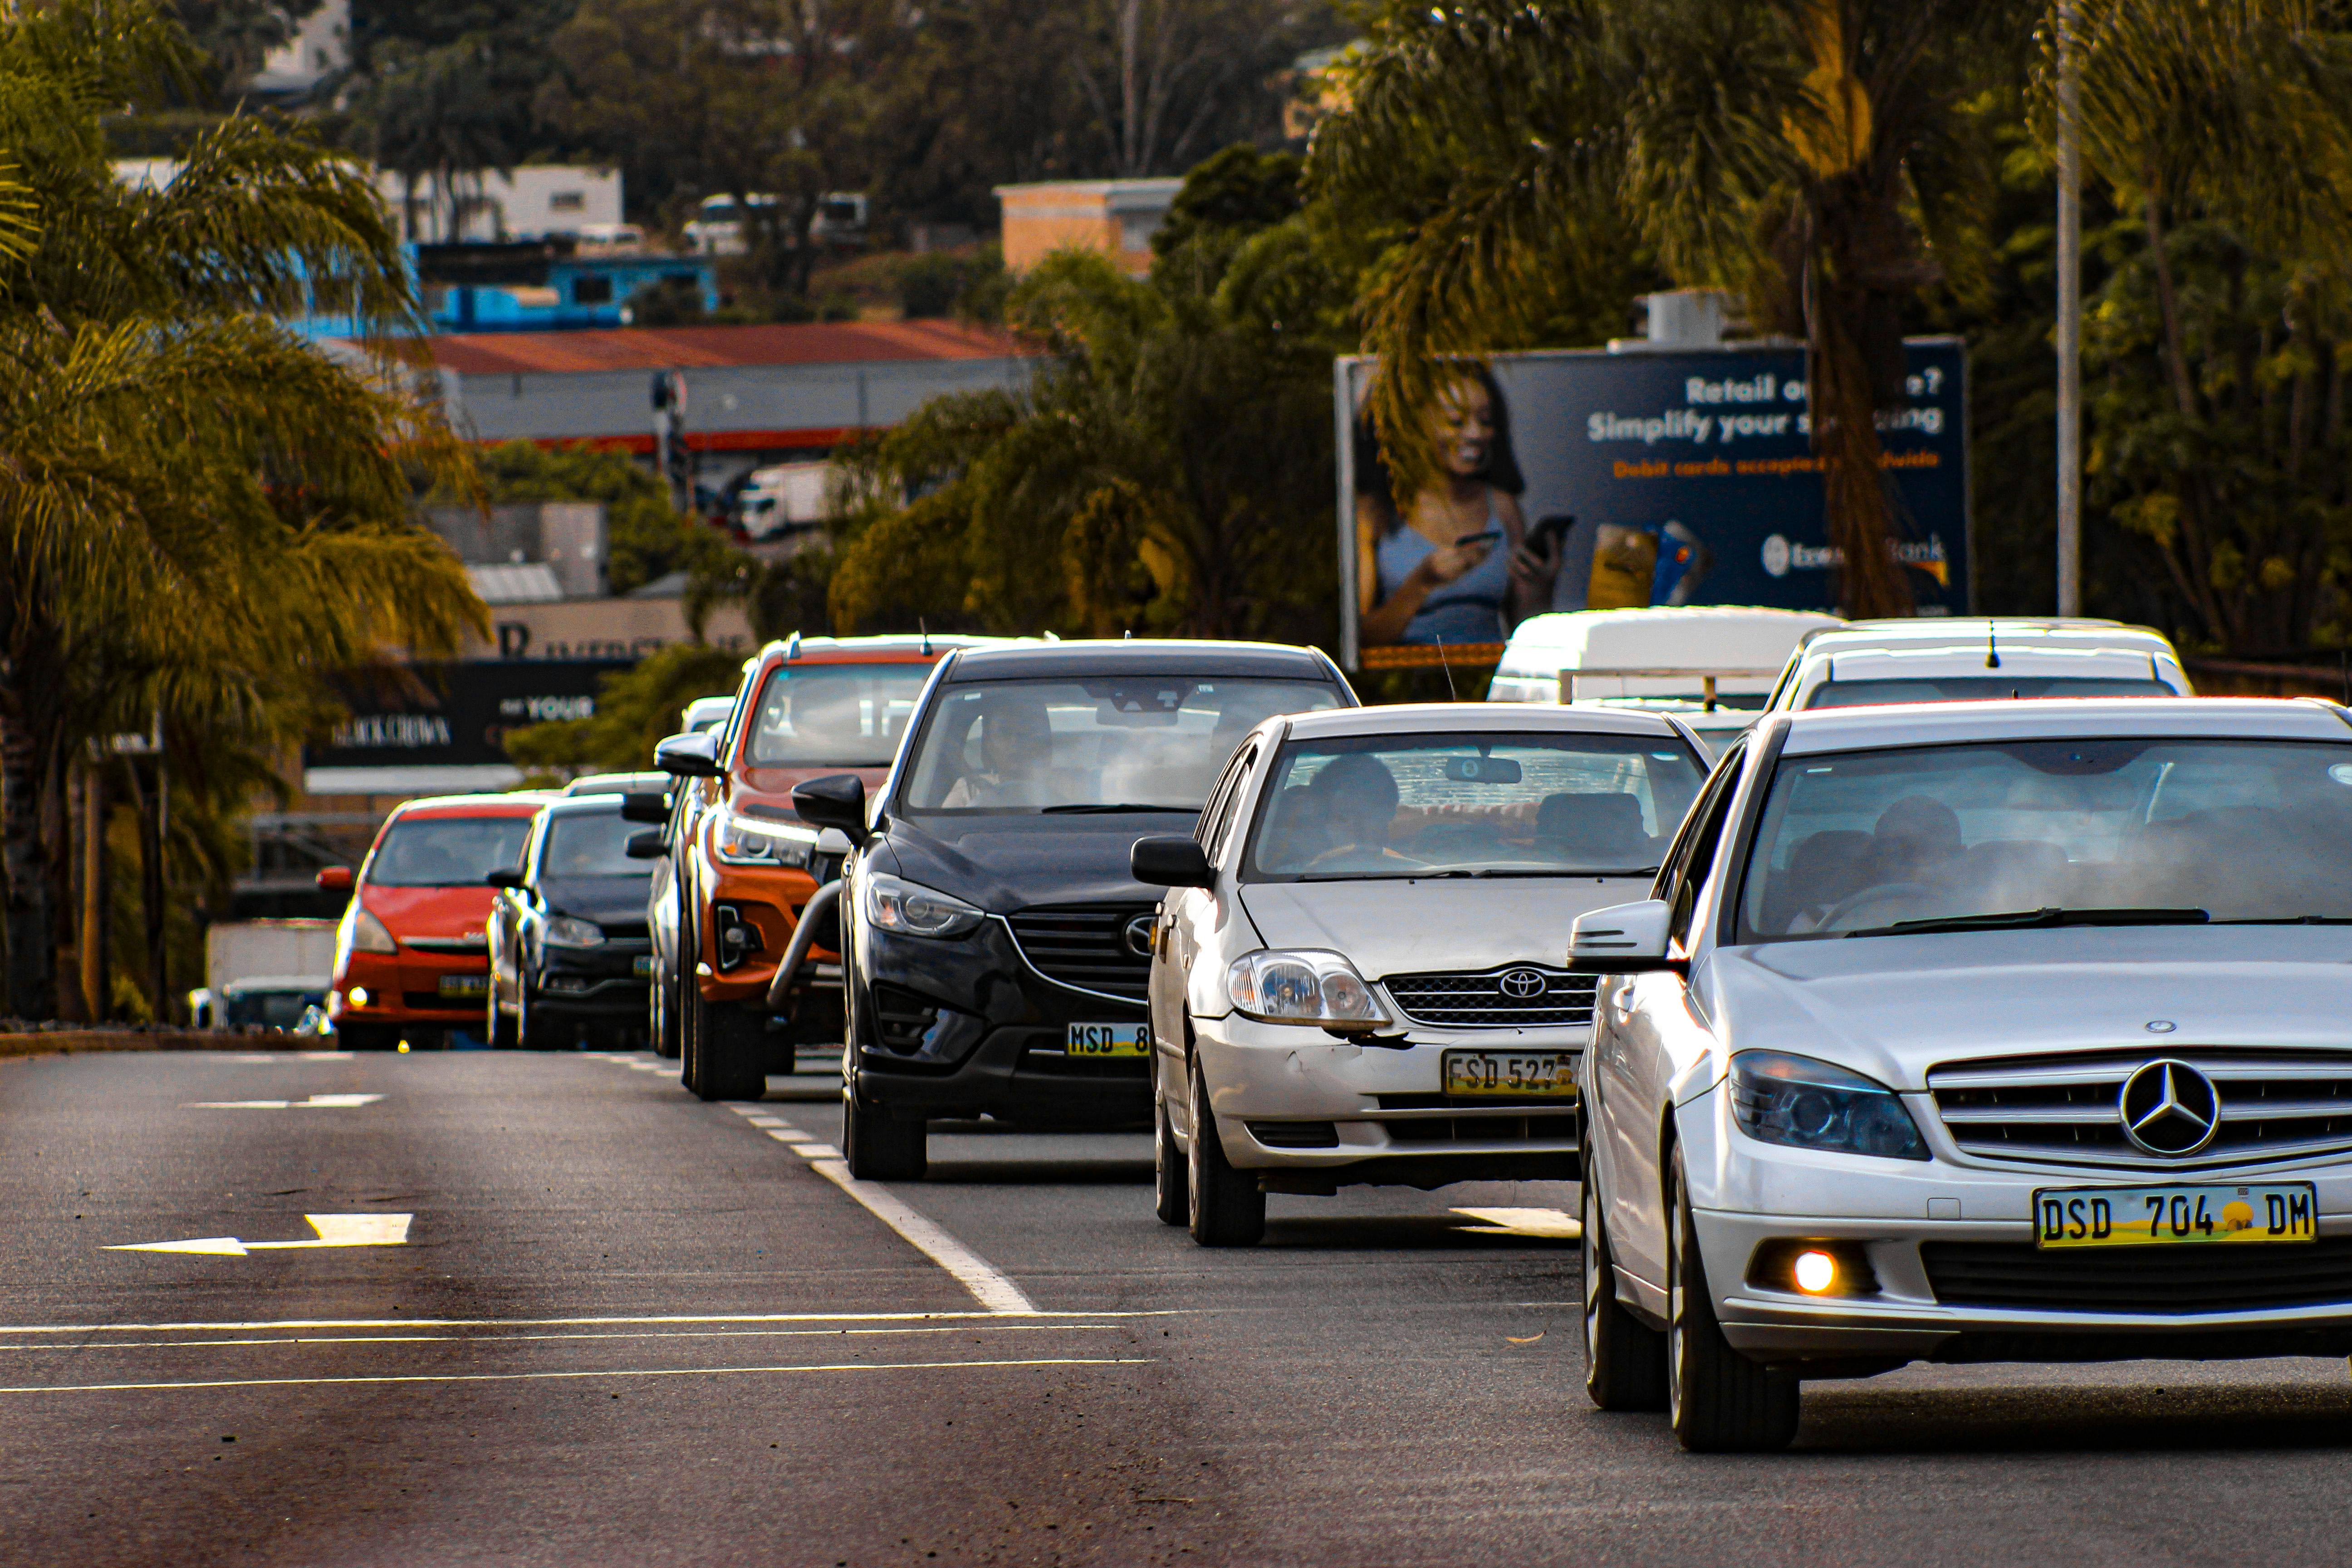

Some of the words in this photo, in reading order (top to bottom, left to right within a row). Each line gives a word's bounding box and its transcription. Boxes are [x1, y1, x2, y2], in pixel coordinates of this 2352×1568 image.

[1686, 373, 1776, 405] Retail
[1588, 409, 1713, 444] Simplify
[1718, 412, 1790, 443] your
[1613, 460, 1668, 478] Debit
[1674, 456, 1730, 476] cards
[526, 695, 595, 721] YOUR
[1071, 1026, 1114, 1052] MSD
[1135, 1026, 1148, 1053] 8
[1447, 1058, 1497, 1088] FSD
[1507, 1059, 1555, 1090] 527
[2042, 1198, 2111, 1240] DSD
[2145, 1194, 2214, 1237] 704
[2264, 1193, 2310, 1235] DM
